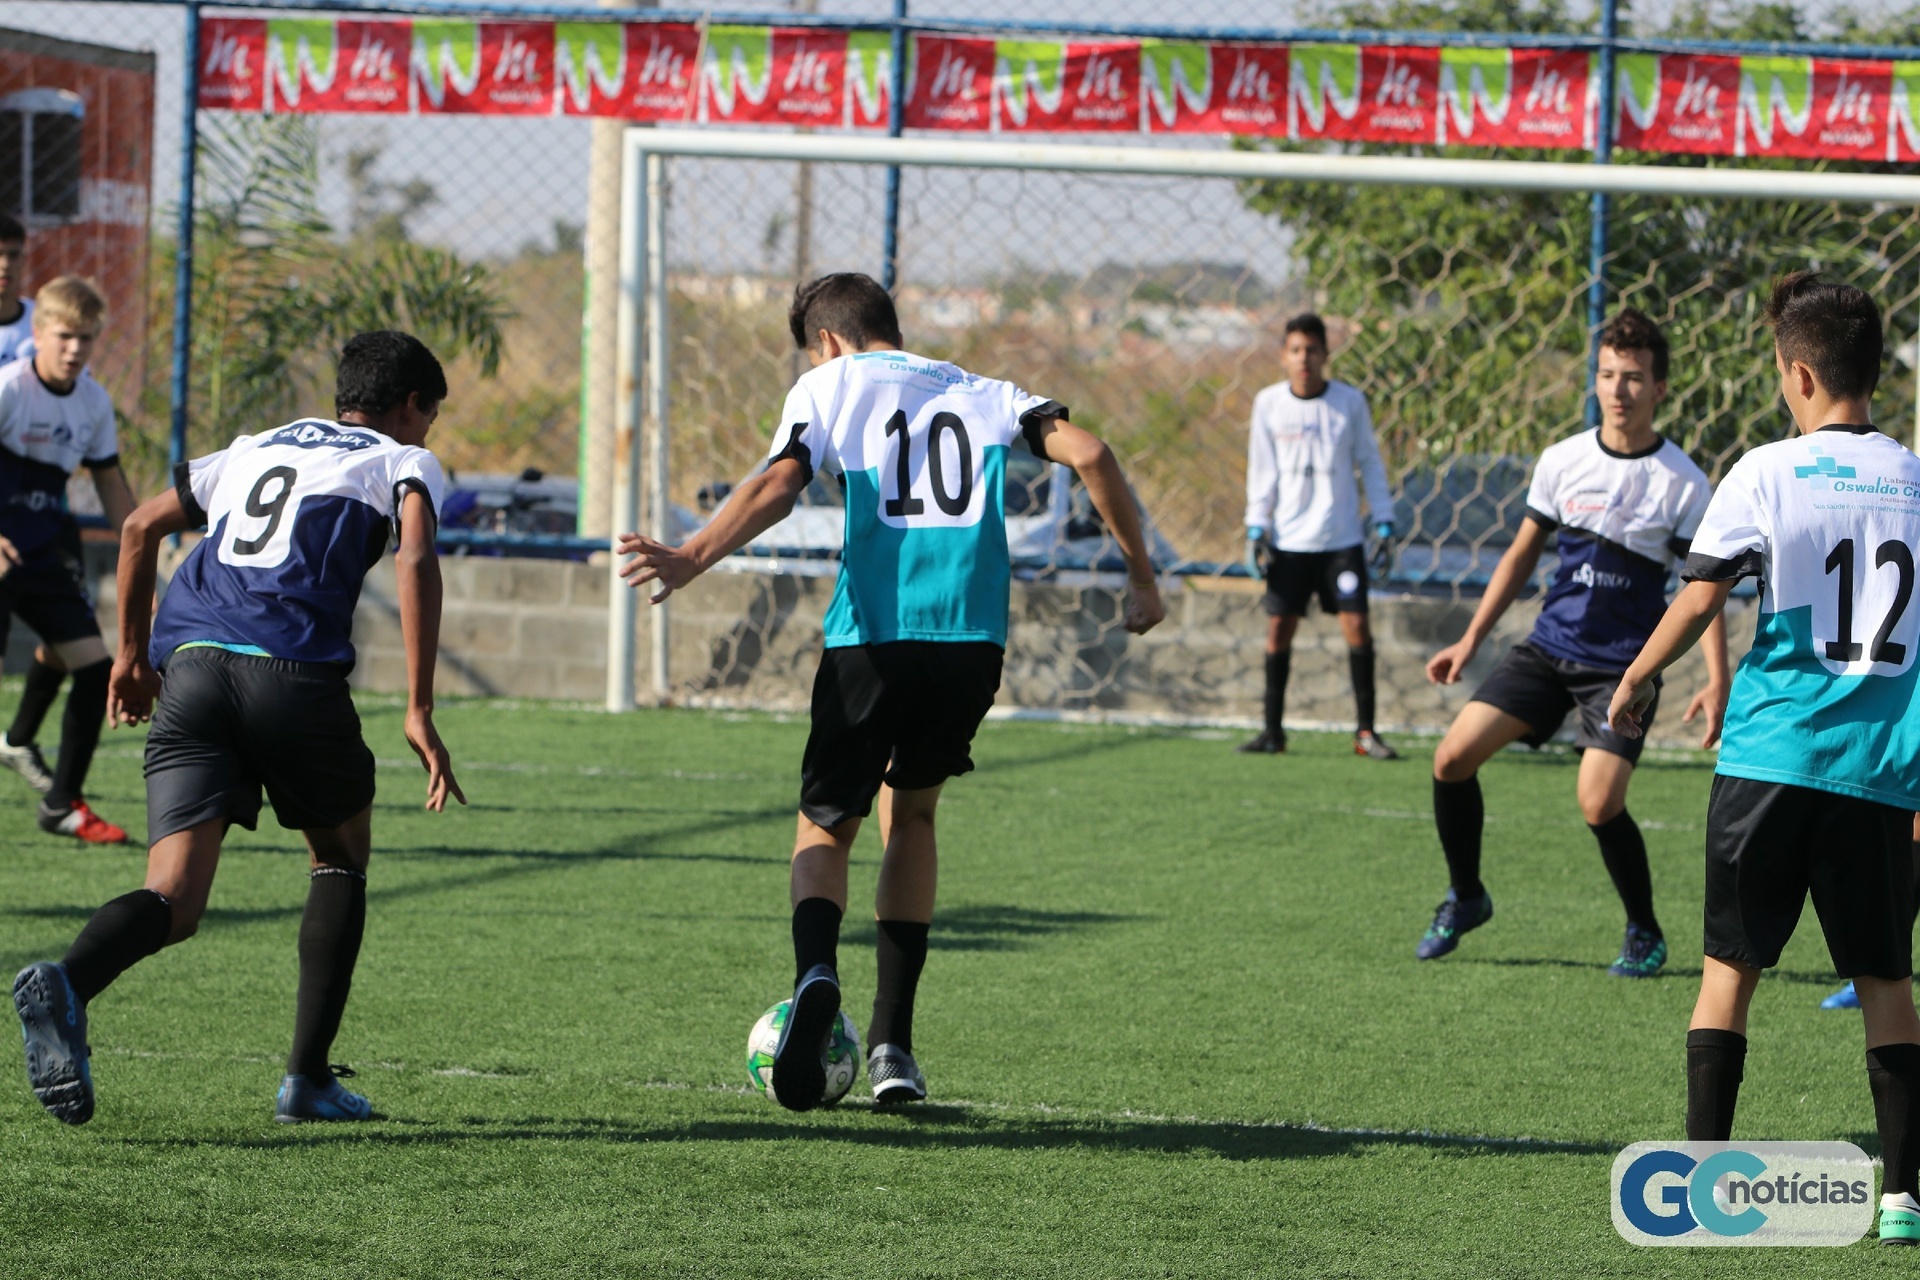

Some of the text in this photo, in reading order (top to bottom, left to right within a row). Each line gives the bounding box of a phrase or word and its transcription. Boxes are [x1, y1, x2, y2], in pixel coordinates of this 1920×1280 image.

[889, 362, 944, 381] Oswaldo
[885, 408, 973, 517] 10
[1834, 476, 1898, 495] Oswaldo
[232, 465, 297, 556] 9
[1825, 538, 1915, 666] 12
